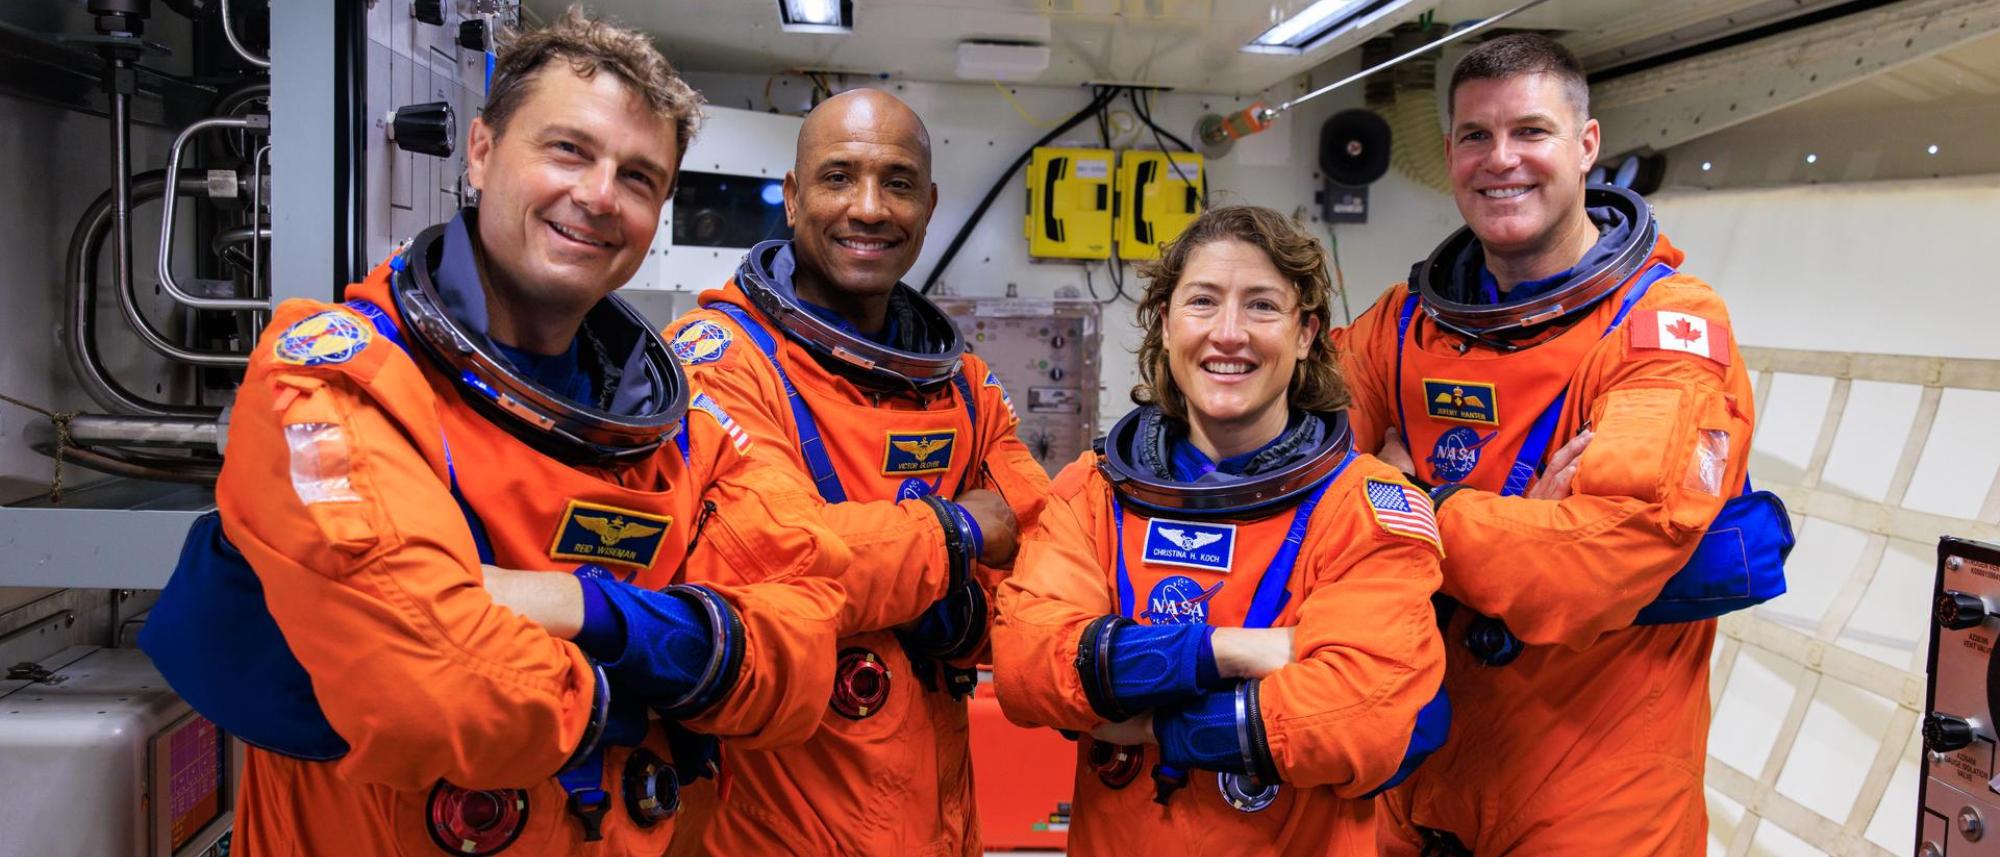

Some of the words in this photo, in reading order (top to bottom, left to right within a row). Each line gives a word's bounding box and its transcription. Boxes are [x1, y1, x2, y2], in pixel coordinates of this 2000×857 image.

[1436, 407, 1457, 416] JEREMY
[1461, 411, 1486, 420] HANSEN
[1436, 444, 1476, 463] NASA
[898, 462, 918, 470] VICTOR
[920, 460, 940, 469] GLOVER
[574, 543, 593, 553] REID
[597, 546, 637, 560] WISEMAN
[1153, 548, 1187, 559] CHRISTINA
[1200, 553, 1220, 563] KOCH
[1152, 598, 1205, 617] NASA
